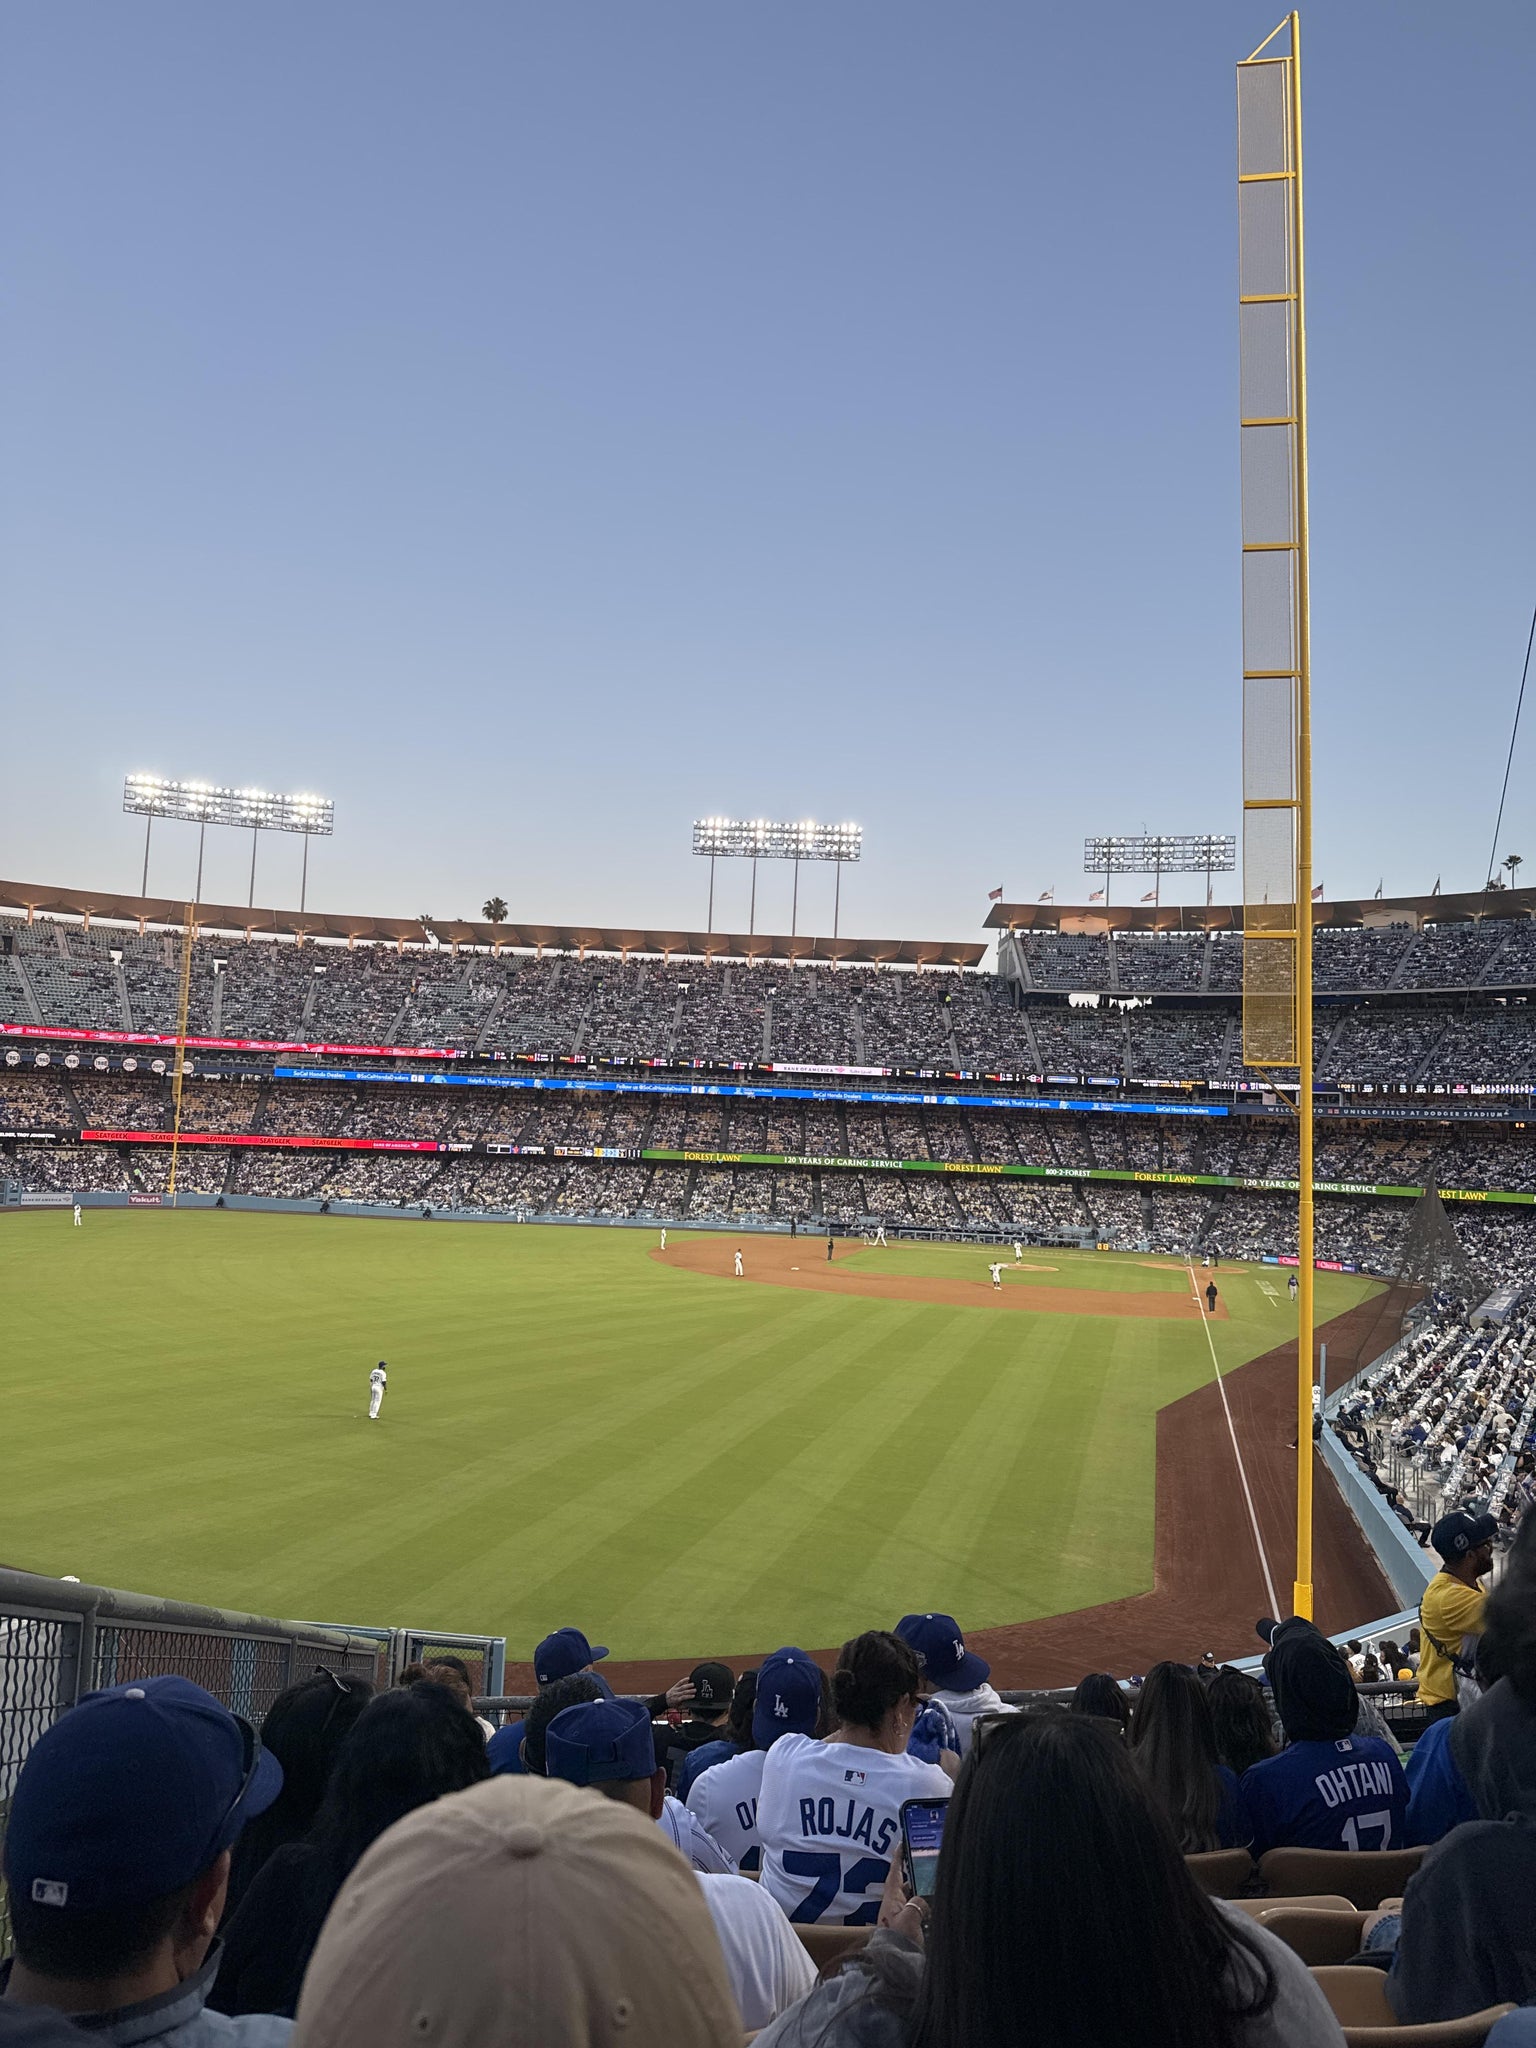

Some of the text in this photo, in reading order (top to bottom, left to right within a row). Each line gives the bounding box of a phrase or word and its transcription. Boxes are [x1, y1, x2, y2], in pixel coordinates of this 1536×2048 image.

[684, 1152, 741, 1162] FOREST LAWN
[871, 1160, 903, 1168] SERVICE
[944, 1163, 1002, 1173] FOREST LAWN
[1045, 1169, 1091, 1177] 800-2-FOREST
[1134, 1172, 1196, 1183] FOREST LAWN
[1312, 1183, 1338, 1191] RING
[1339, 1184, 1376, 1193] SERVICE
[1459, 1190, 1486, 1200] LAWN
[774, 1694, 789, 1718] LA
[1315, 1762, 1394, 1809] OHTANI
[799, 1796, 898, 1856] ROJAS
[1340, 1809, 1392, 1852] 17
